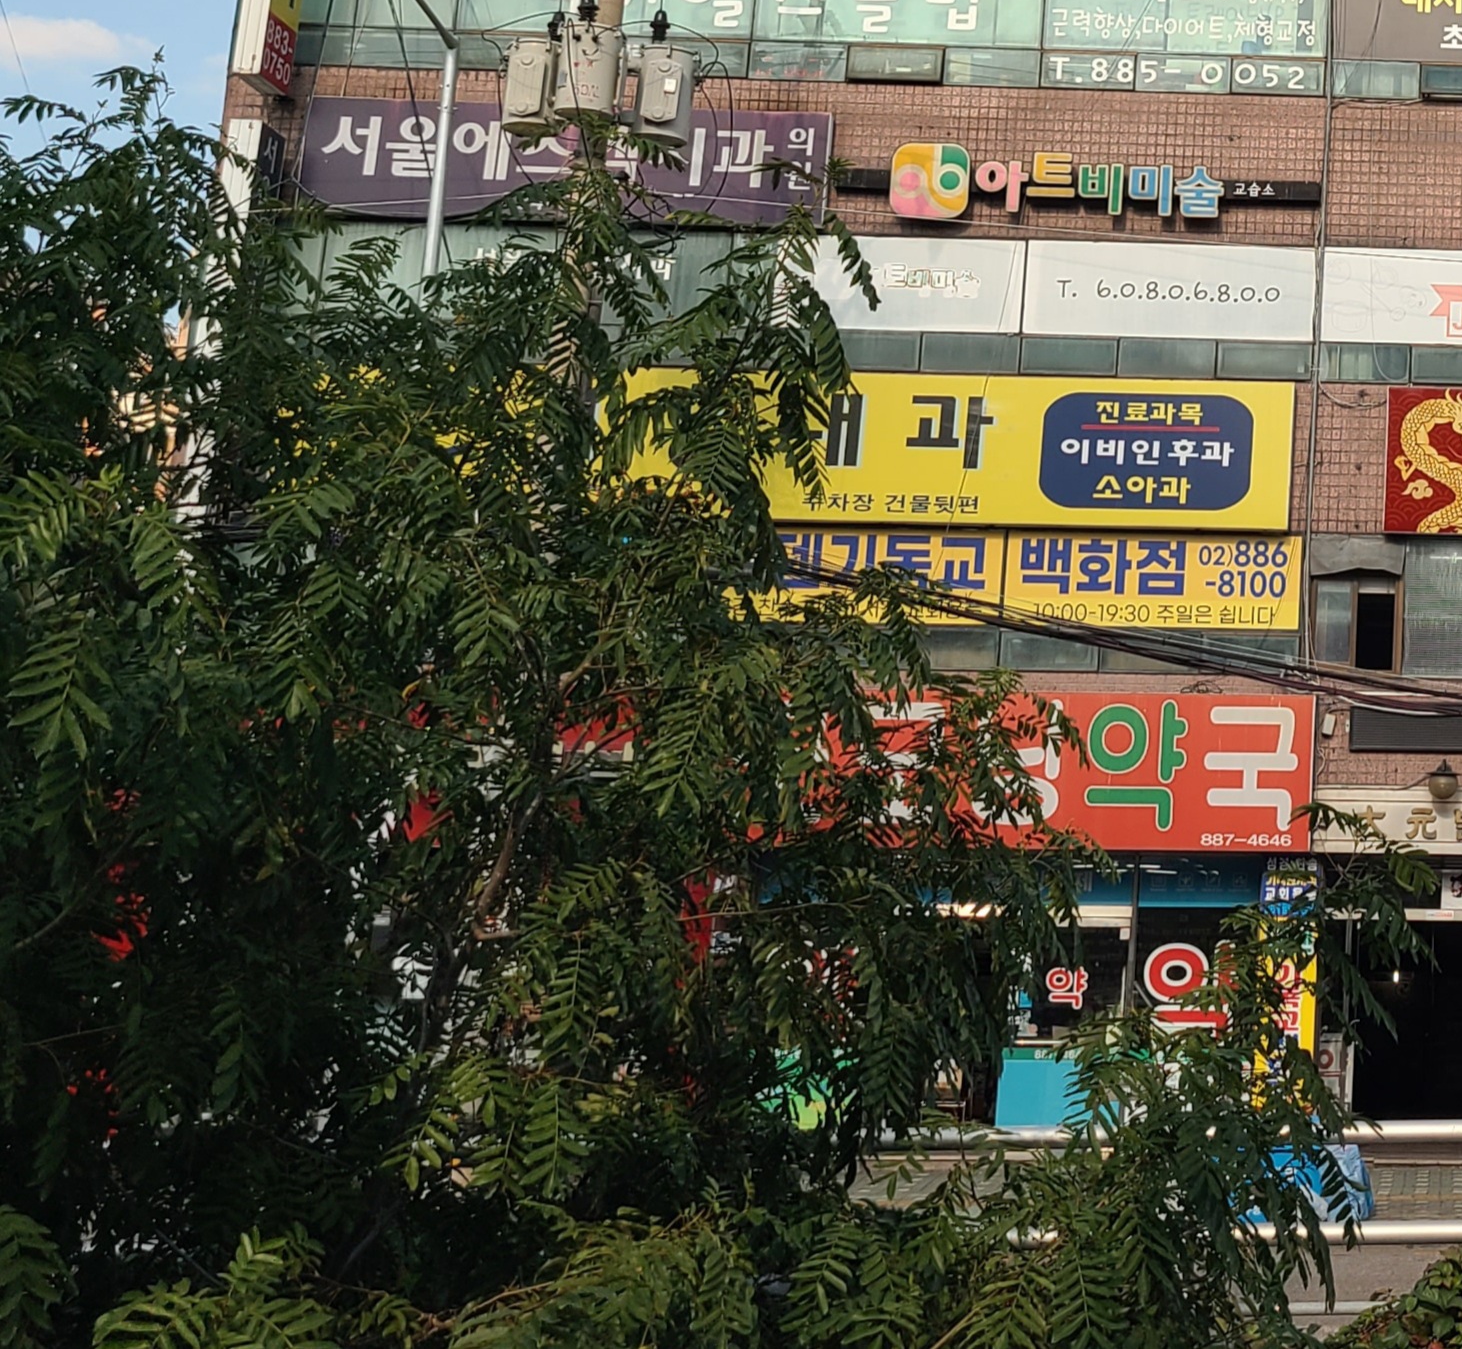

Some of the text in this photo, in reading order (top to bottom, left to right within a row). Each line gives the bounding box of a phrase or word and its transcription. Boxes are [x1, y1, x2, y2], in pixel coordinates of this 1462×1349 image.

[262, 51, 292, 86] 0750
[975, 151, 1225, 220] 아트비미술
[1232, 181, 1276, 198] 교습소
[1095, 401, 1204, 426] 진료과목
[1061, 438, 1235, 468] 이비인후과
[1093, 474, 1191, 504] 소아과
[885, 493, 979, 515] 건물뒷편
[1020, 537, 1188, 596] 백화점
[1198, 539, 1289, 568] 02)886
[1205, 569, 1287, 598] -8100
[1032, 602, 1277, 626] 10:00-19:30 주일은 쉽니다
[1200, 833, 1292, 848] 887-4646
[1046, 966, 1089, 1010] 약
